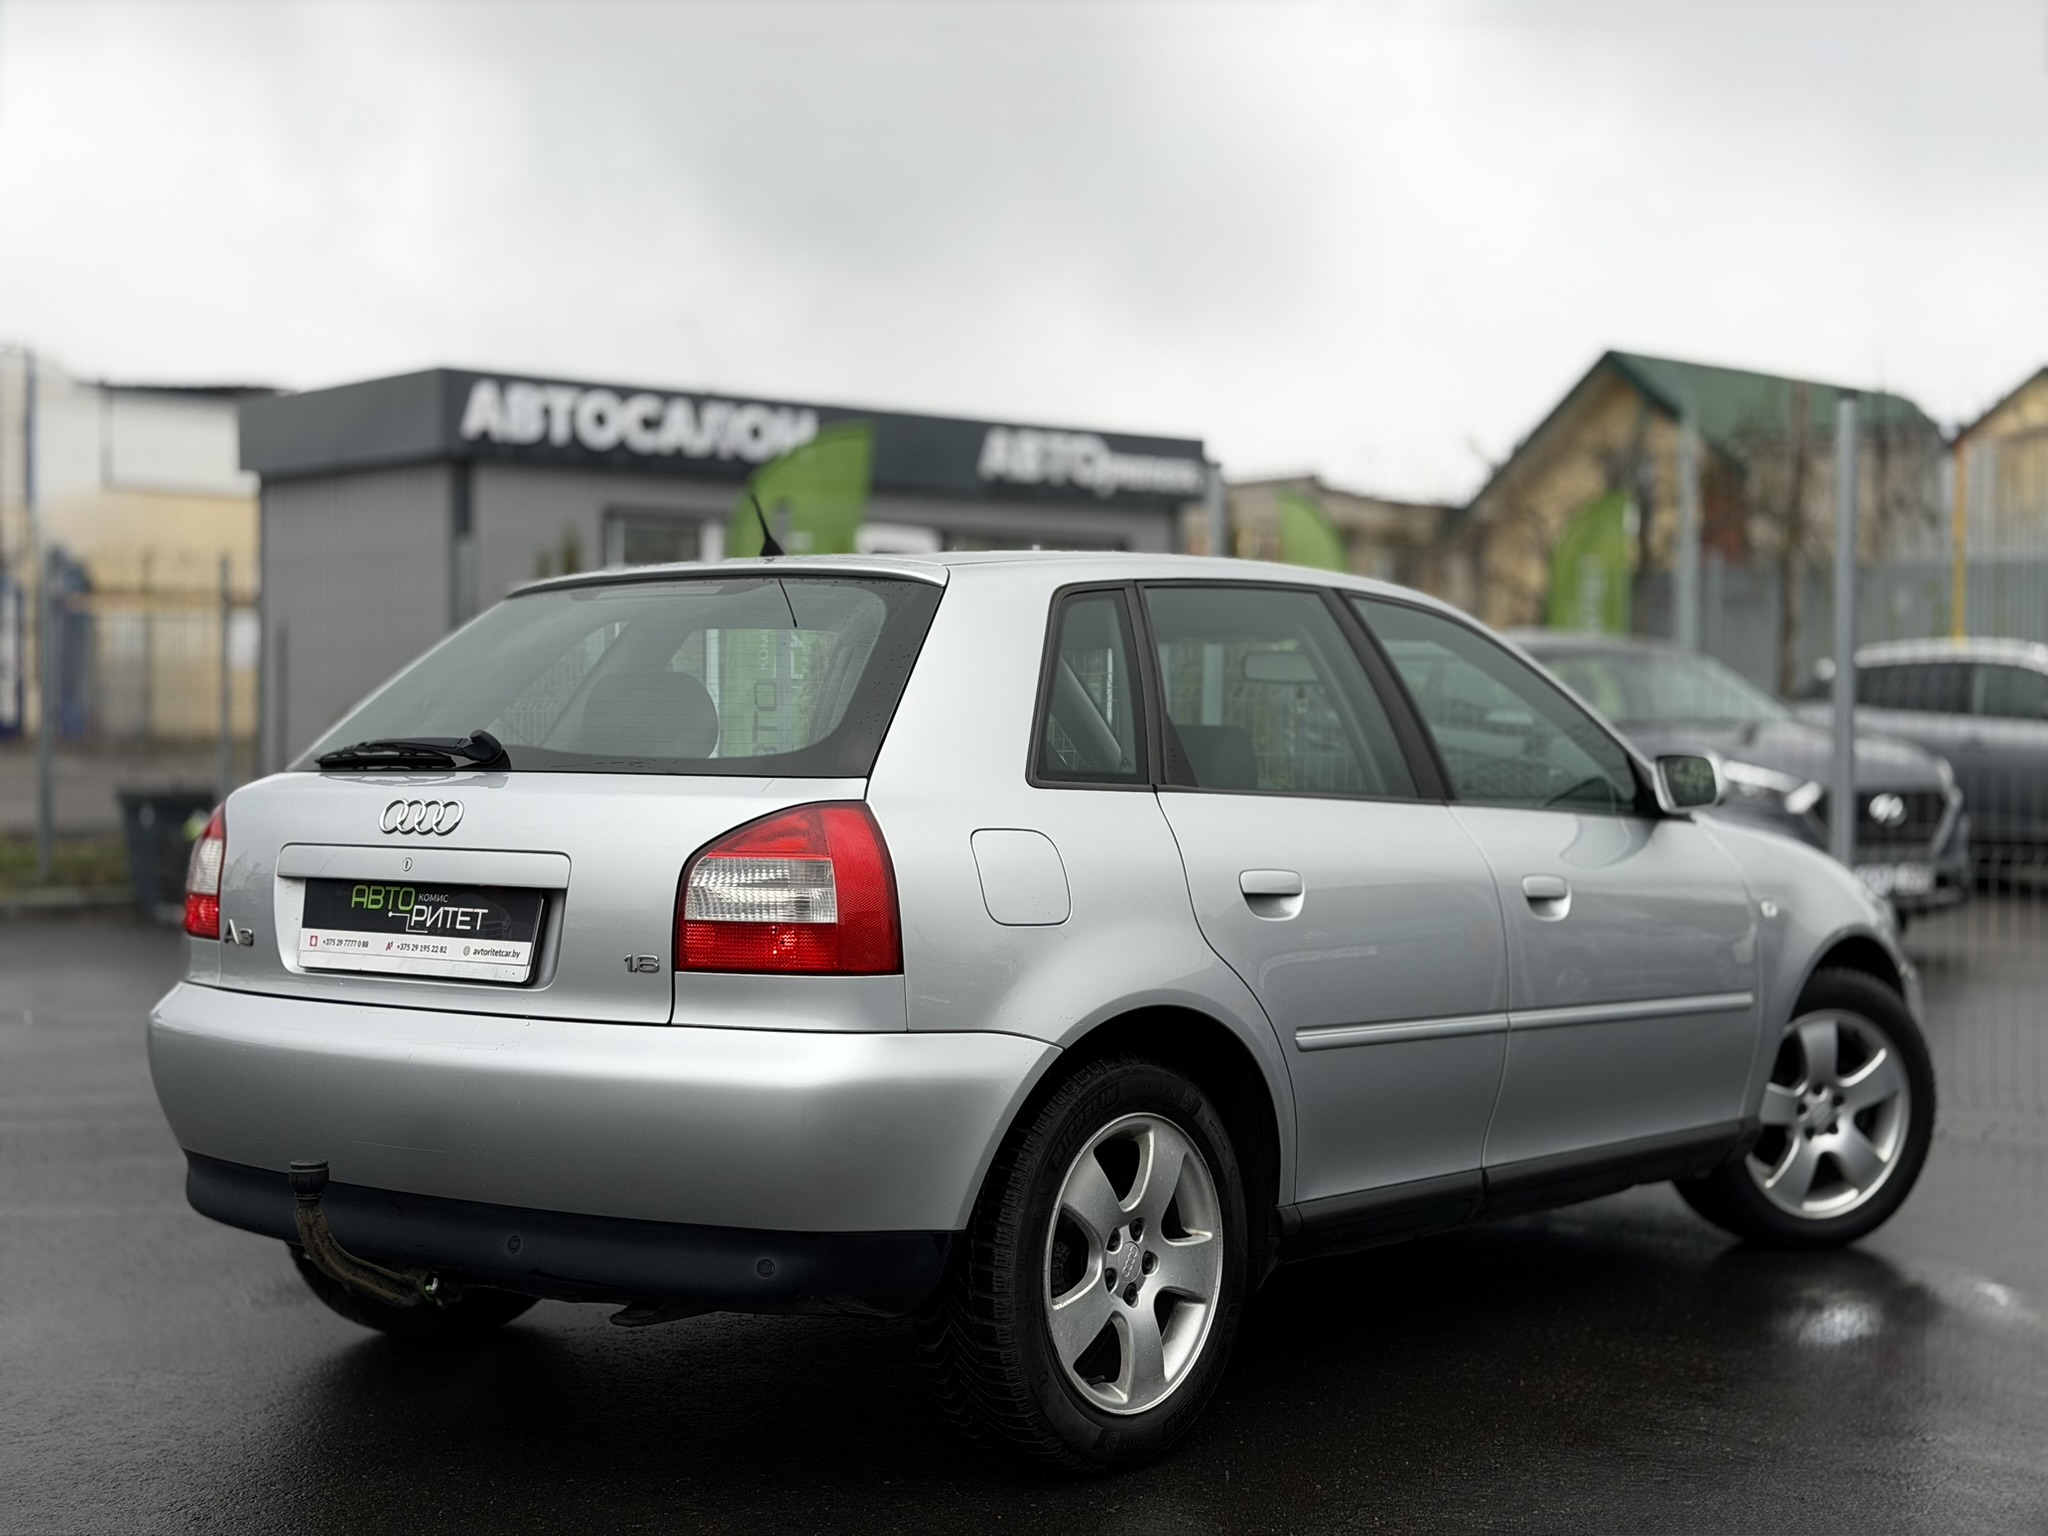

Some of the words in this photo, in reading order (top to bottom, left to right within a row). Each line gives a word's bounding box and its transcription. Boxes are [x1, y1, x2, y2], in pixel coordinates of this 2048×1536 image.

[460, 377, 819, 464] АВТОСАЛОН
[350, 884, 416, 911] АВТО
[418, 893, 449, 903] КОМИС
[410, 905, 489, 931] РИТЕТ
[223, 918, 254, 947] A3
[322, 938, 336, 947] +375
[336, 938, 343, 947] 29
[396, 942, 411, 951] +375
[411, 943, 419, 952] 29
[419, 944, 431, 953] 195
[431, 945, 439, 954] 22
[472, 947, 521, 960] avtoritetcar.by
[623, 954, 660, 974] 1.6
